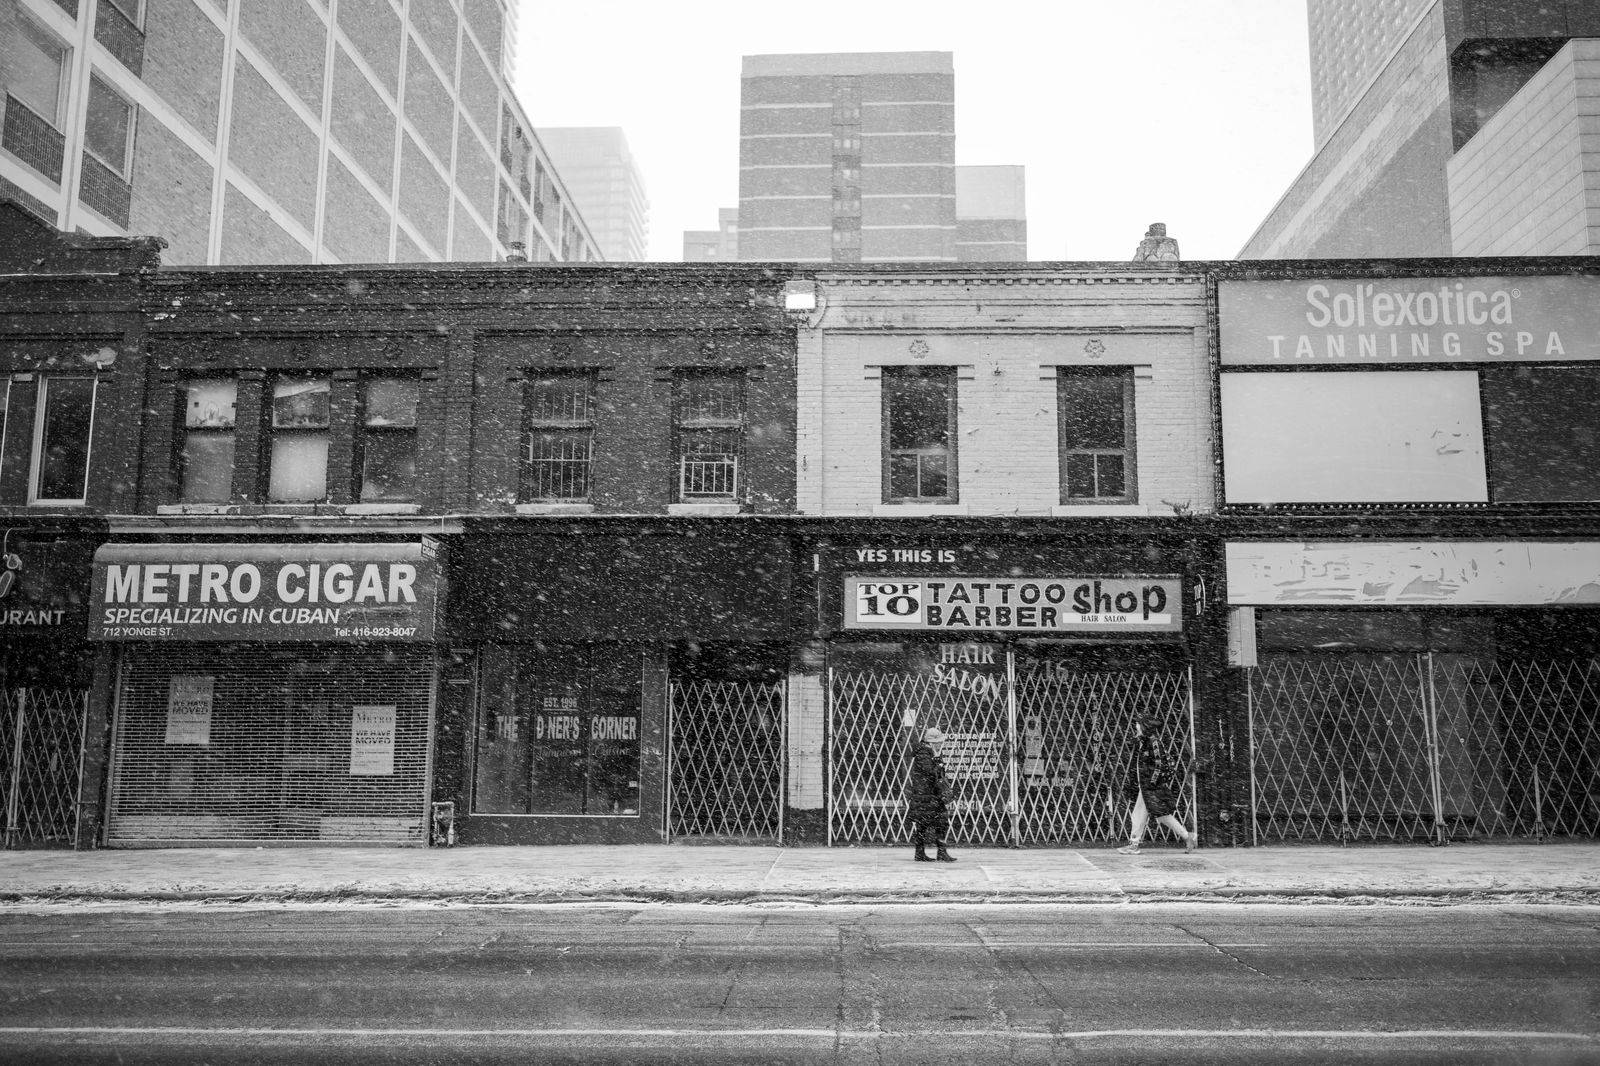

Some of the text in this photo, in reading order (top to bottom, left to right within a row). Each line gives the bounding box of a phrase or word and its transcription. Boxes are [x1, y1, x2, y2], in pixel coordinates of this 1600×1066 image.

[1267, 331, 1566, 359] TANNING SPA
[856, 549, 956, 563] YES THIS IS
[105, 563, 417, 603] METRO CIGAR
[859, 583, 919, 595] TOP
[927, 582, 1066, 604] TATTOO
[103, 608, 340, 624] SPECIALIZING IN CUBAN
[859, 595, 920, 616] 10
[926, 605, 1058, 627] BARBER
[1081, 615, 1127, 623] HAIR SALON
[103, 627, 174, 637] 712 YONGE ST.
[334, 627, 417, 637] Tel: 416-923-8047
[940, 643, 995, 664] HAIR
[933, 664, 1000, 699] SALON
[496, 716, 637, 740] THE DNER'S CORNER
